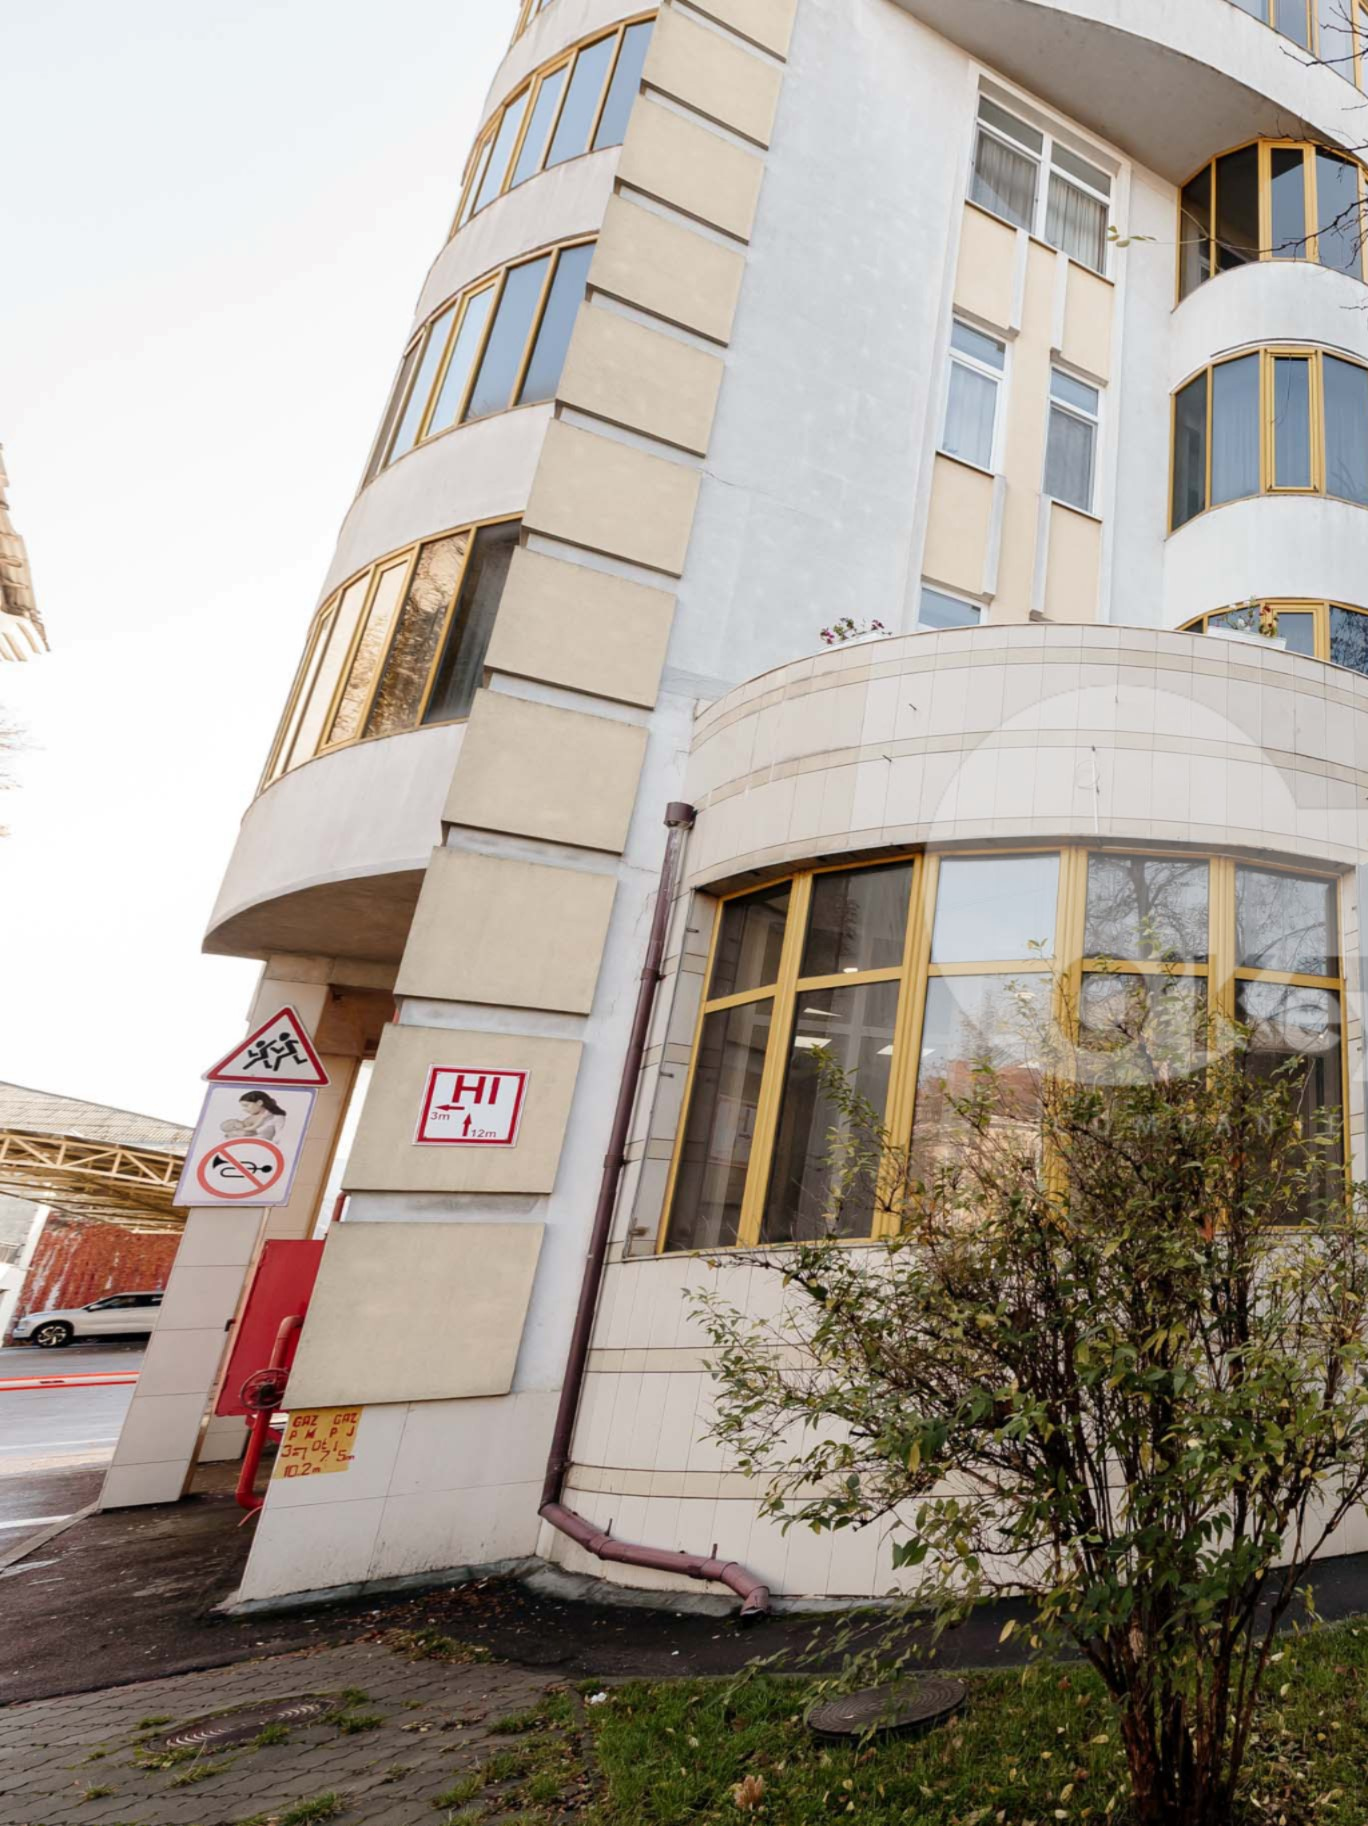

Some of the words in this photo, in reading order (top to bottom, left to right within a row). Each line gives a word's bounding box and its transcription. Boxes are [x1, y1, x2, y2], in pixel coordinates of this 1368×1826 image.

[451, 1074, 501, 1105] HI
[430, 1111, 450, 1121] 3m
[471, 1128, 497, 1138] 12m
[292, 1415, 318, 1427] GAZ
[333, 1412, 357, 1425] GAZ
[329, 1427, 338, 1438] P
